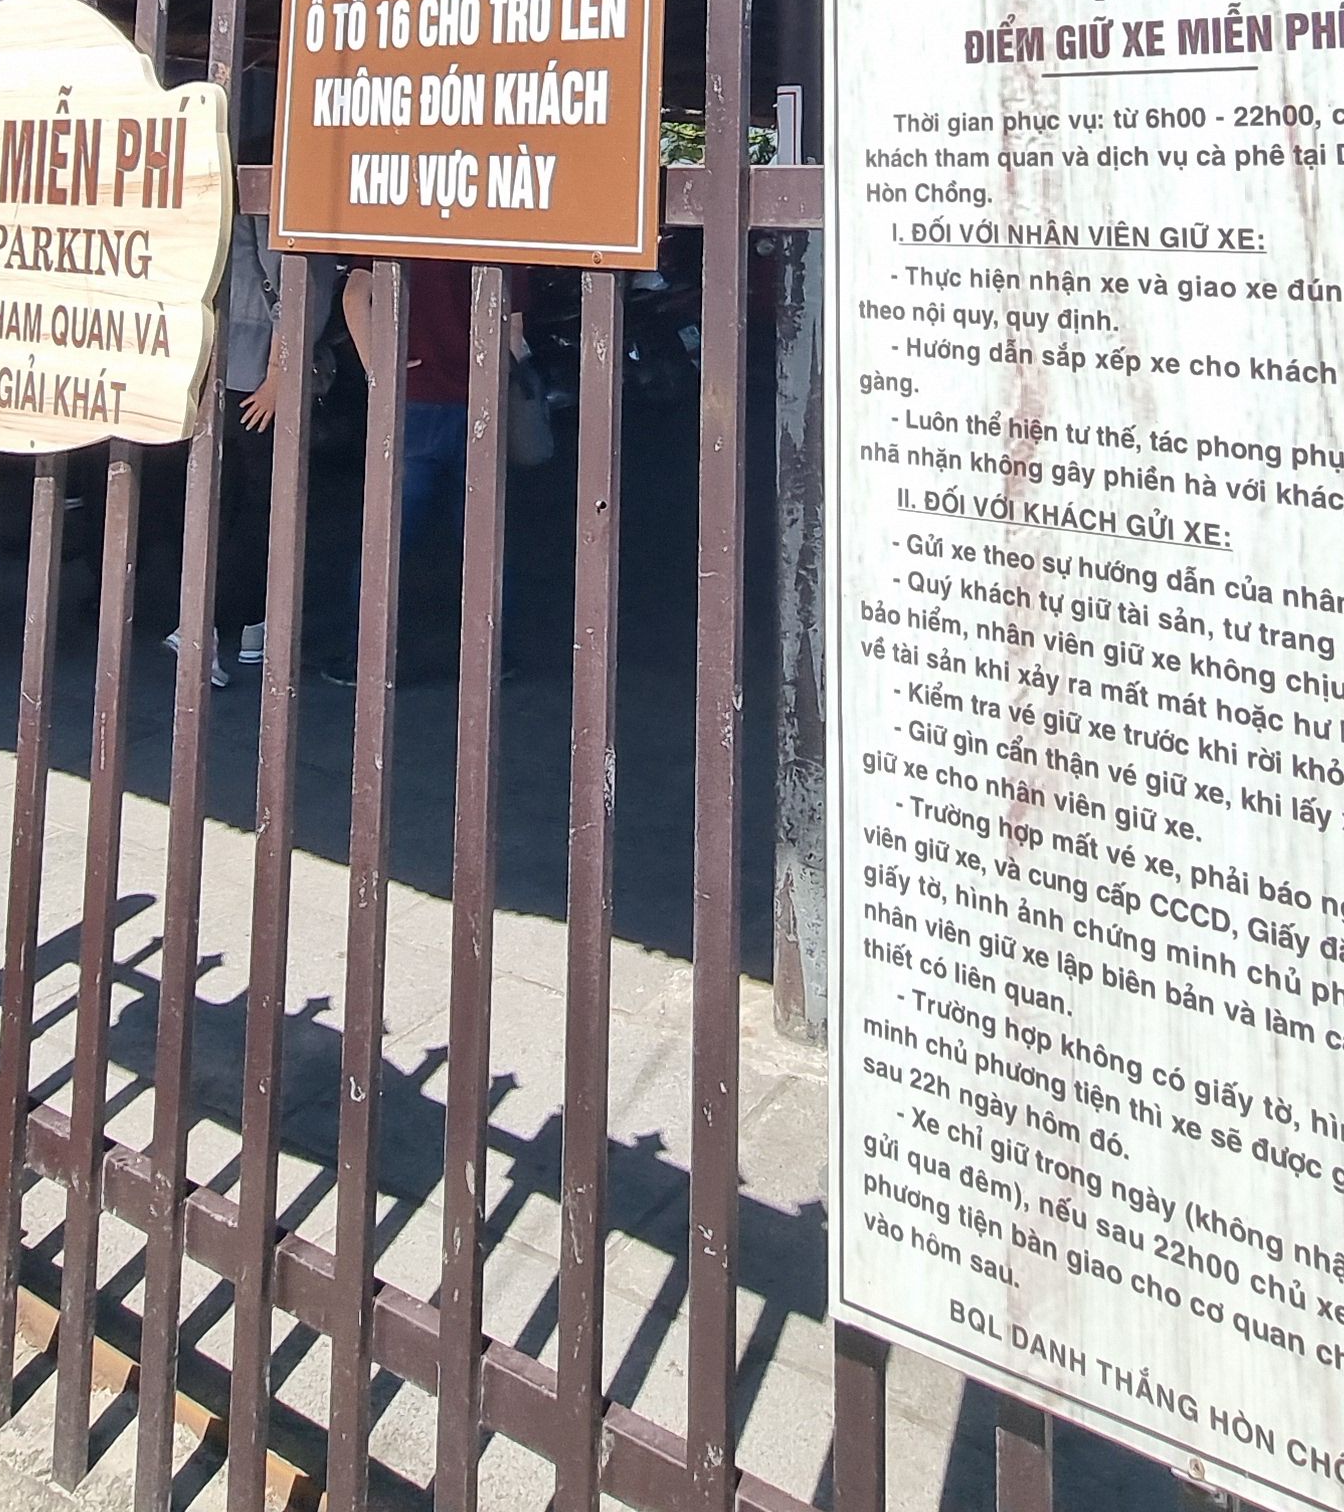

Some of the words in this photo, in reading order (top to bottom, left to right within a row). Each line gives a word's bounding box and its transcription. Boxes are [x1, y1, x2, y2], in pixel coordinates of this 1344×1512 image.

[964, 13, 1044, 64] ĐIỂM
[1055, 15, 1114, 60] GIỮ
[1121, 19, 1165, 58] XE
[1177, 1, 1272, 55] MIỄN
[311, 65, 413, 127] KHÔNG
[418, 62, 486, 127] ĐÓN
[492, 58, 609, 126] KHÁCH
[892, 112, 939, 132] Thời
[947, 111, 993, 137] gian
[1002, 110, 1059, 137] phục
[1067, 113, 1103, 134] vụ:
[1112, 106, 1139, 129] từ
[1145, 106, 1206, 128] 6h00
[1233, 103, 1321, 129] 22h00,
[113, 96, 189, 209] PHÍ
[348, 152, 411, 206] KHU
[417, 147, 479, 219] VỰC
[486, 142, 557, 210] NÀY
[865, 147, 927, 167] khách
[934, 147, 989, 167] tham
[997, 151, 1053, 172] quan
[1061, 145, 1089, 166] và
[1096, 145, 1148, 170] dịch
[1156, 149, 1187, 171] vụ
[1196, 143, 1226, 166] cà
[1234, 143, 1284, 171] phê
[1291, 142, 1326, 170] tại
[866, 182, 906, 202] Hòn
[914, 179, 992, 208] Chồng.
[911, 214, 951, 243] ĐỐI
[958, 218, 998, 244] VỚI
[1007, 218, 1078, 246] NHÂN
[1087, 220, 1149, 247] VIÊN
[1159, 221, 1209, 249] GIỮ
[1216, 227, 1264, 250] XE:
[904, 265, 961, 291] Thực
[969, 267, 1020, 293] hiện
[1029, 269, 1091, 296] nhận
[1100, 276, 1129, 294] xe
[1137, 272, 1168, 295] và
[1177, 274, 1236, 302] giao
[1245, 281, 1277, 300] xe
[51, 304, 124, 352] QUAN
[134, 301, 169, 357] VÀ
[53, 367, 126, 424] KHÁT
[859, 369, 919, 397] gàng.
[860, 441, 899, 463] nhã
[907, 445, 961, 472] nhặn
[970, 450, 1042, 484] không
[1051, 460, 1095, 489] gây
[1103, 465, 1174, 492] phiền
[1184, 471, 1216, 497] hà
[1225, 478, 1265, 502] với
[897, 487, 915, 508] II.
[923, 484, 964, 515] ĐỐI
[972, 492, 1014, 521] VỚI
[1023, 500, 1116, 533] KHÁCH
[1125, 507, 1174, 540] GỬI
[1183, 520, 1230, 547] XE:
[906, 532, 943, 558] Gửi
[951, 543, 976, 562] xe
[982, 544, 1035, 570] theo
[1042, 555, 1072, 579] sự
[1078, 555, 1157, 593] hướng
[1166, 565, 1215, 596] dẫn
[1224, 574, 1272, 604] của
[860, 636, 885, 659] về
[891, 642, 918, 665] tài
[926, 646, 966, 674] sản
[975, 655, 1009, 682] khi
[1017, 663, 1059, 696] xảy
[1068, 676, 1091, 697] ra
[1100, 680, 1149, 707] mất
[1157, 691, 1207, 718] mát
[1216, 697, 1283, 733] hoặc
[1293, 711, 1332, 740] hư
[909, 795, 990, 839] Trường
[998, 815, 1043, 850] hợp
[1052, 831, 1098, 860] mất
[1105, 843, 1135, 868] vé
[1144, 854, 1181, 883] xe,
[1190, 863, 1248, 895] phải
[1258, 875, 1312, 909] báo
[911, 1106, 939, 1135] Xe
[947, 1122, 982, 1150] chỉ
[990, 1138, 1029, 1166] giữ
[1034, 1149, 1101, 1198] trong
[1111, 1180, 1175, 1223] ngày
[1184, 1201, 1283, 1262] (không
[863, 1211, 903, 1242] vào
[911, 1225, 961, 1265] hôm
[969, 1253, 1019, 1288] sau.
[863, 1173, 949, 1225] phương
[957, 1204, 1002, 1240] tiện
[1011, 1222, 1057, 1261] bàn
[1066, 1248, 1122, 1284] giao
[1130, 1273, 1181, 1307] cho
[1189, 1296, 1224, 1323] cơ
[1232, 1312, 1305, 1356] quan
[949, 1298, 1002, 1340] BQL
[1011, 1323, 1085, 1376] DANH
[1095, 1358, 1198, 1422] THẮNG
[1209, 1405, 1274, 1455] HÒN
